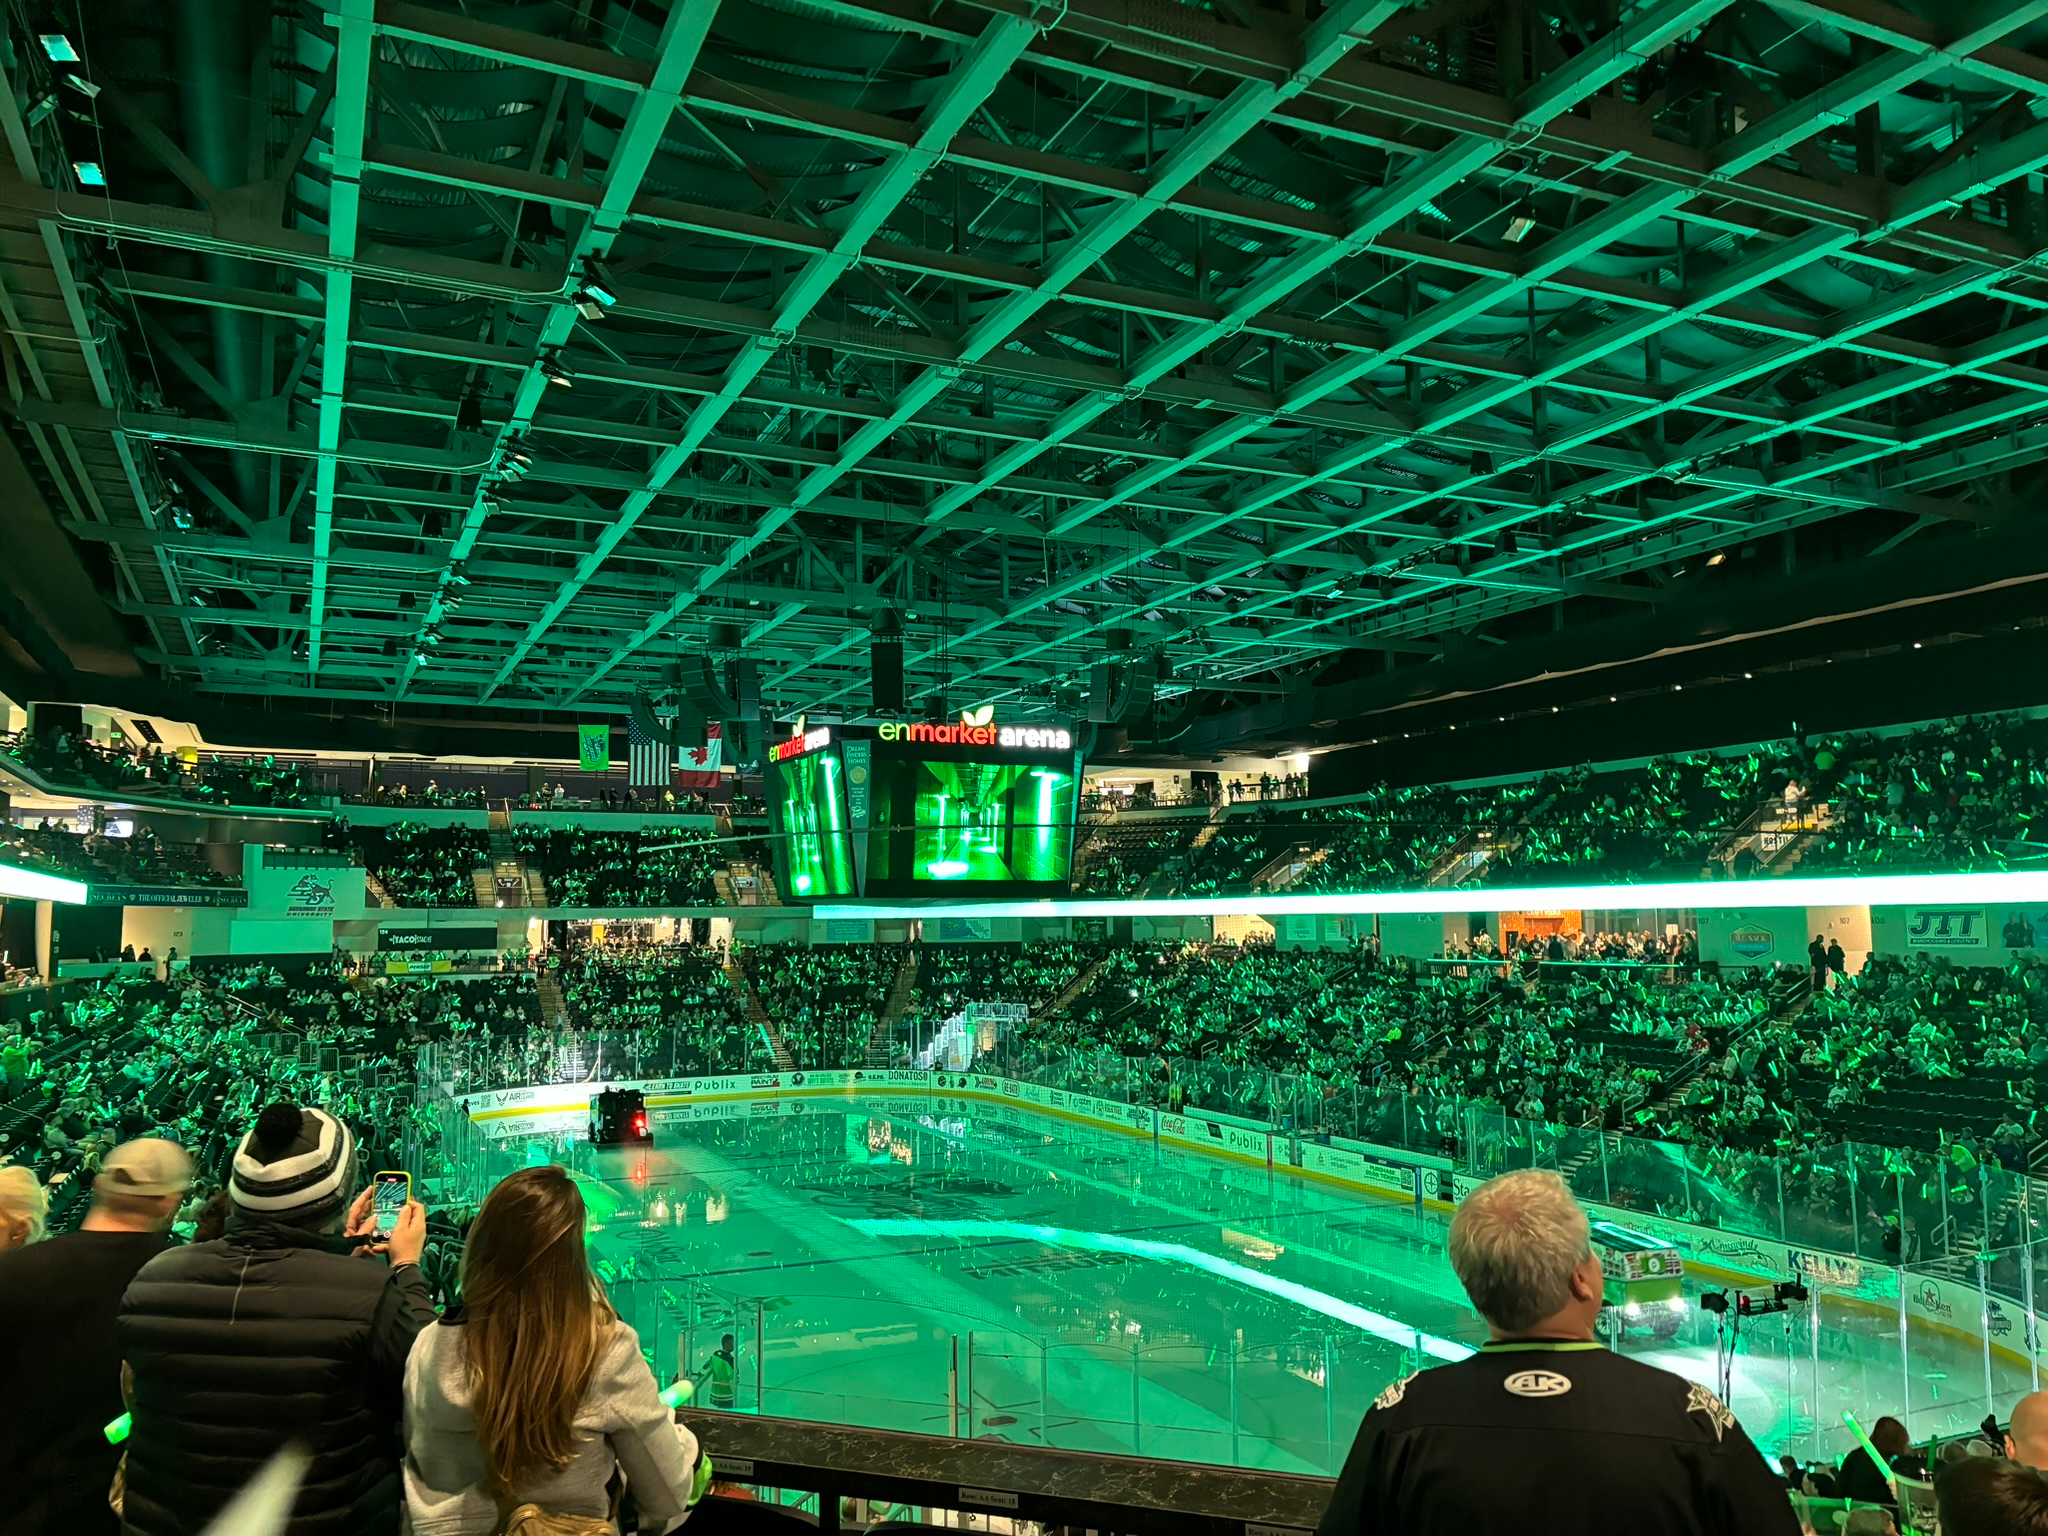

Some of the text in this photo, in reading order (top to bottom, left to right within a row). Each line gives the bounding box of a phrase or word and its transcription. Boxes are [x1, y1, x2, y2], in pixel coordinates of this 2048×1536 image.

[769, 727, 830, 763] enmarket arena
[878, 721, 1071, 749] enmarket arena
[1839, 917, 1850, 925] 107
[694, 1080, 736, 1091] Publix
[508, 1092, 521, 1101] AIR
[1229, 1131, 1263, 1152] Publix
[1787, 1249, 1848, 1280] KELLY
